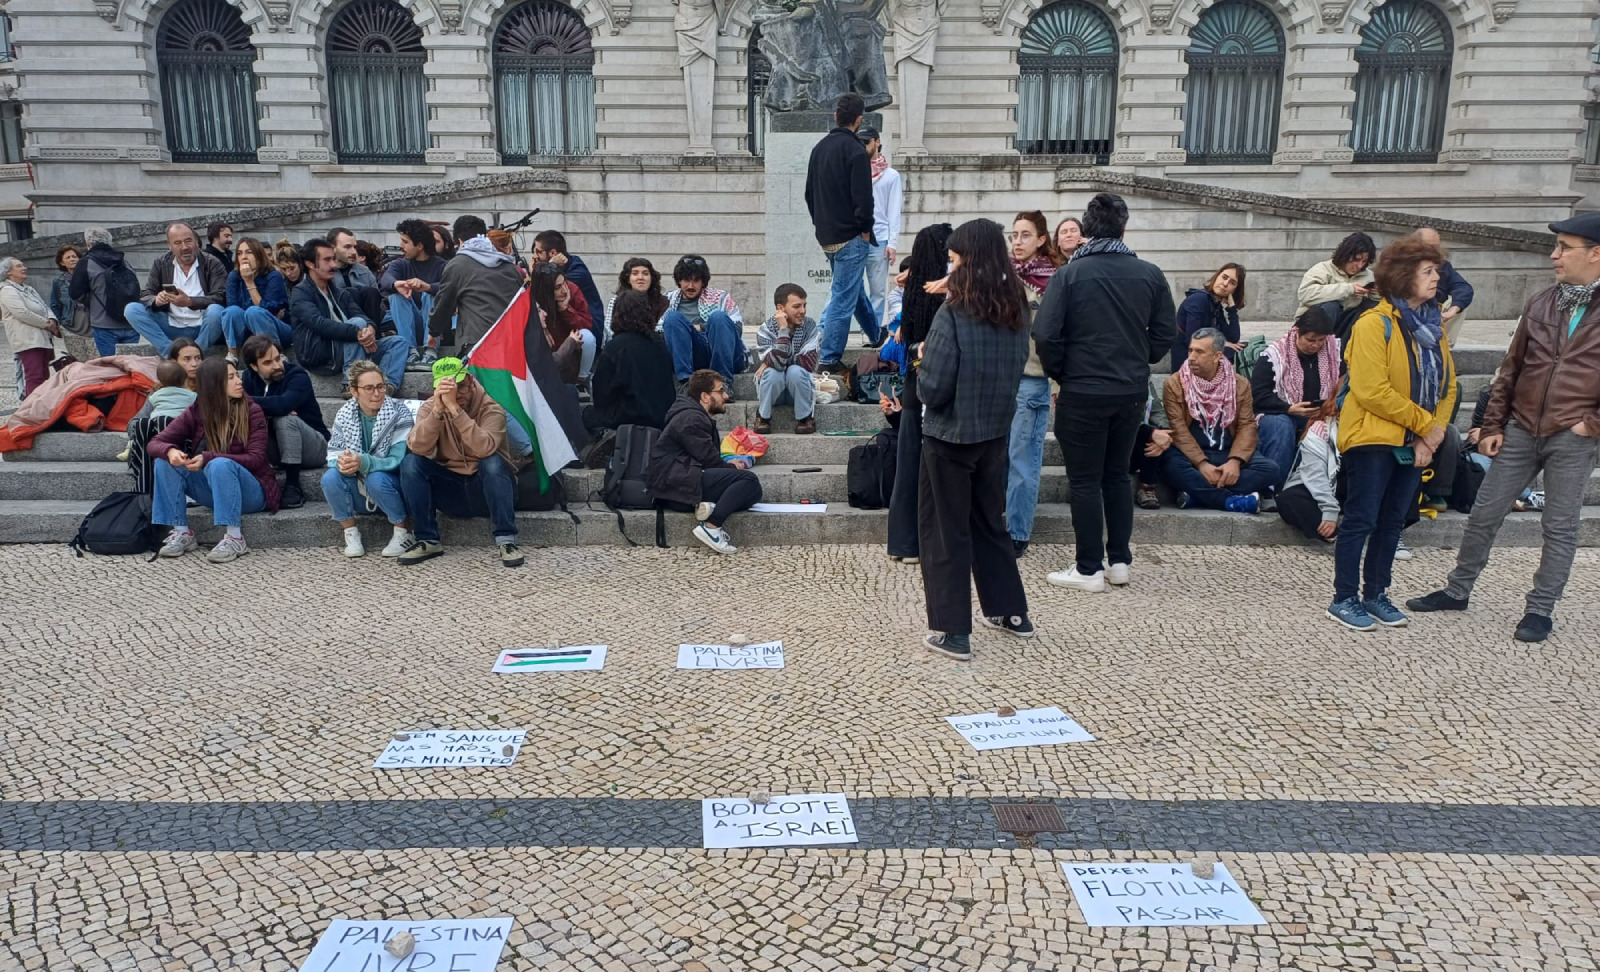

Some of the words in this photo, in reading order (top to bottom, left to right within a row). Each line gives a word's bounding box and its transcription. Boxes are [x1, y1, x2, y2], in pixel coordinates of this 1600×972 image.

[693, 646, 781, 656] PALESTINA
[695, 656, 780, 667] LIVRE
[972, 718, 1020, 729] PAULO
[440, 733, 523, 744] SANGUE
[989, 728, 1072, 741] FLOTILHA
[387, 744, 431, 752] NAS
[381, 756, 416, 764] SR
[421, 756, 513, 765] MINISTRO
[712, 800, 844, 818] BOICOTE
[714, 819, 728, 829] A
[1073, 867, 1149, 876] DEIXEM
[1171, 867, 1183, 875] A
[1082, 880, 1239, 898] FLOTILHA
[1115, 905, 1239, 923] PASSAR
[339, 926, 503, 945] PALESTINA
